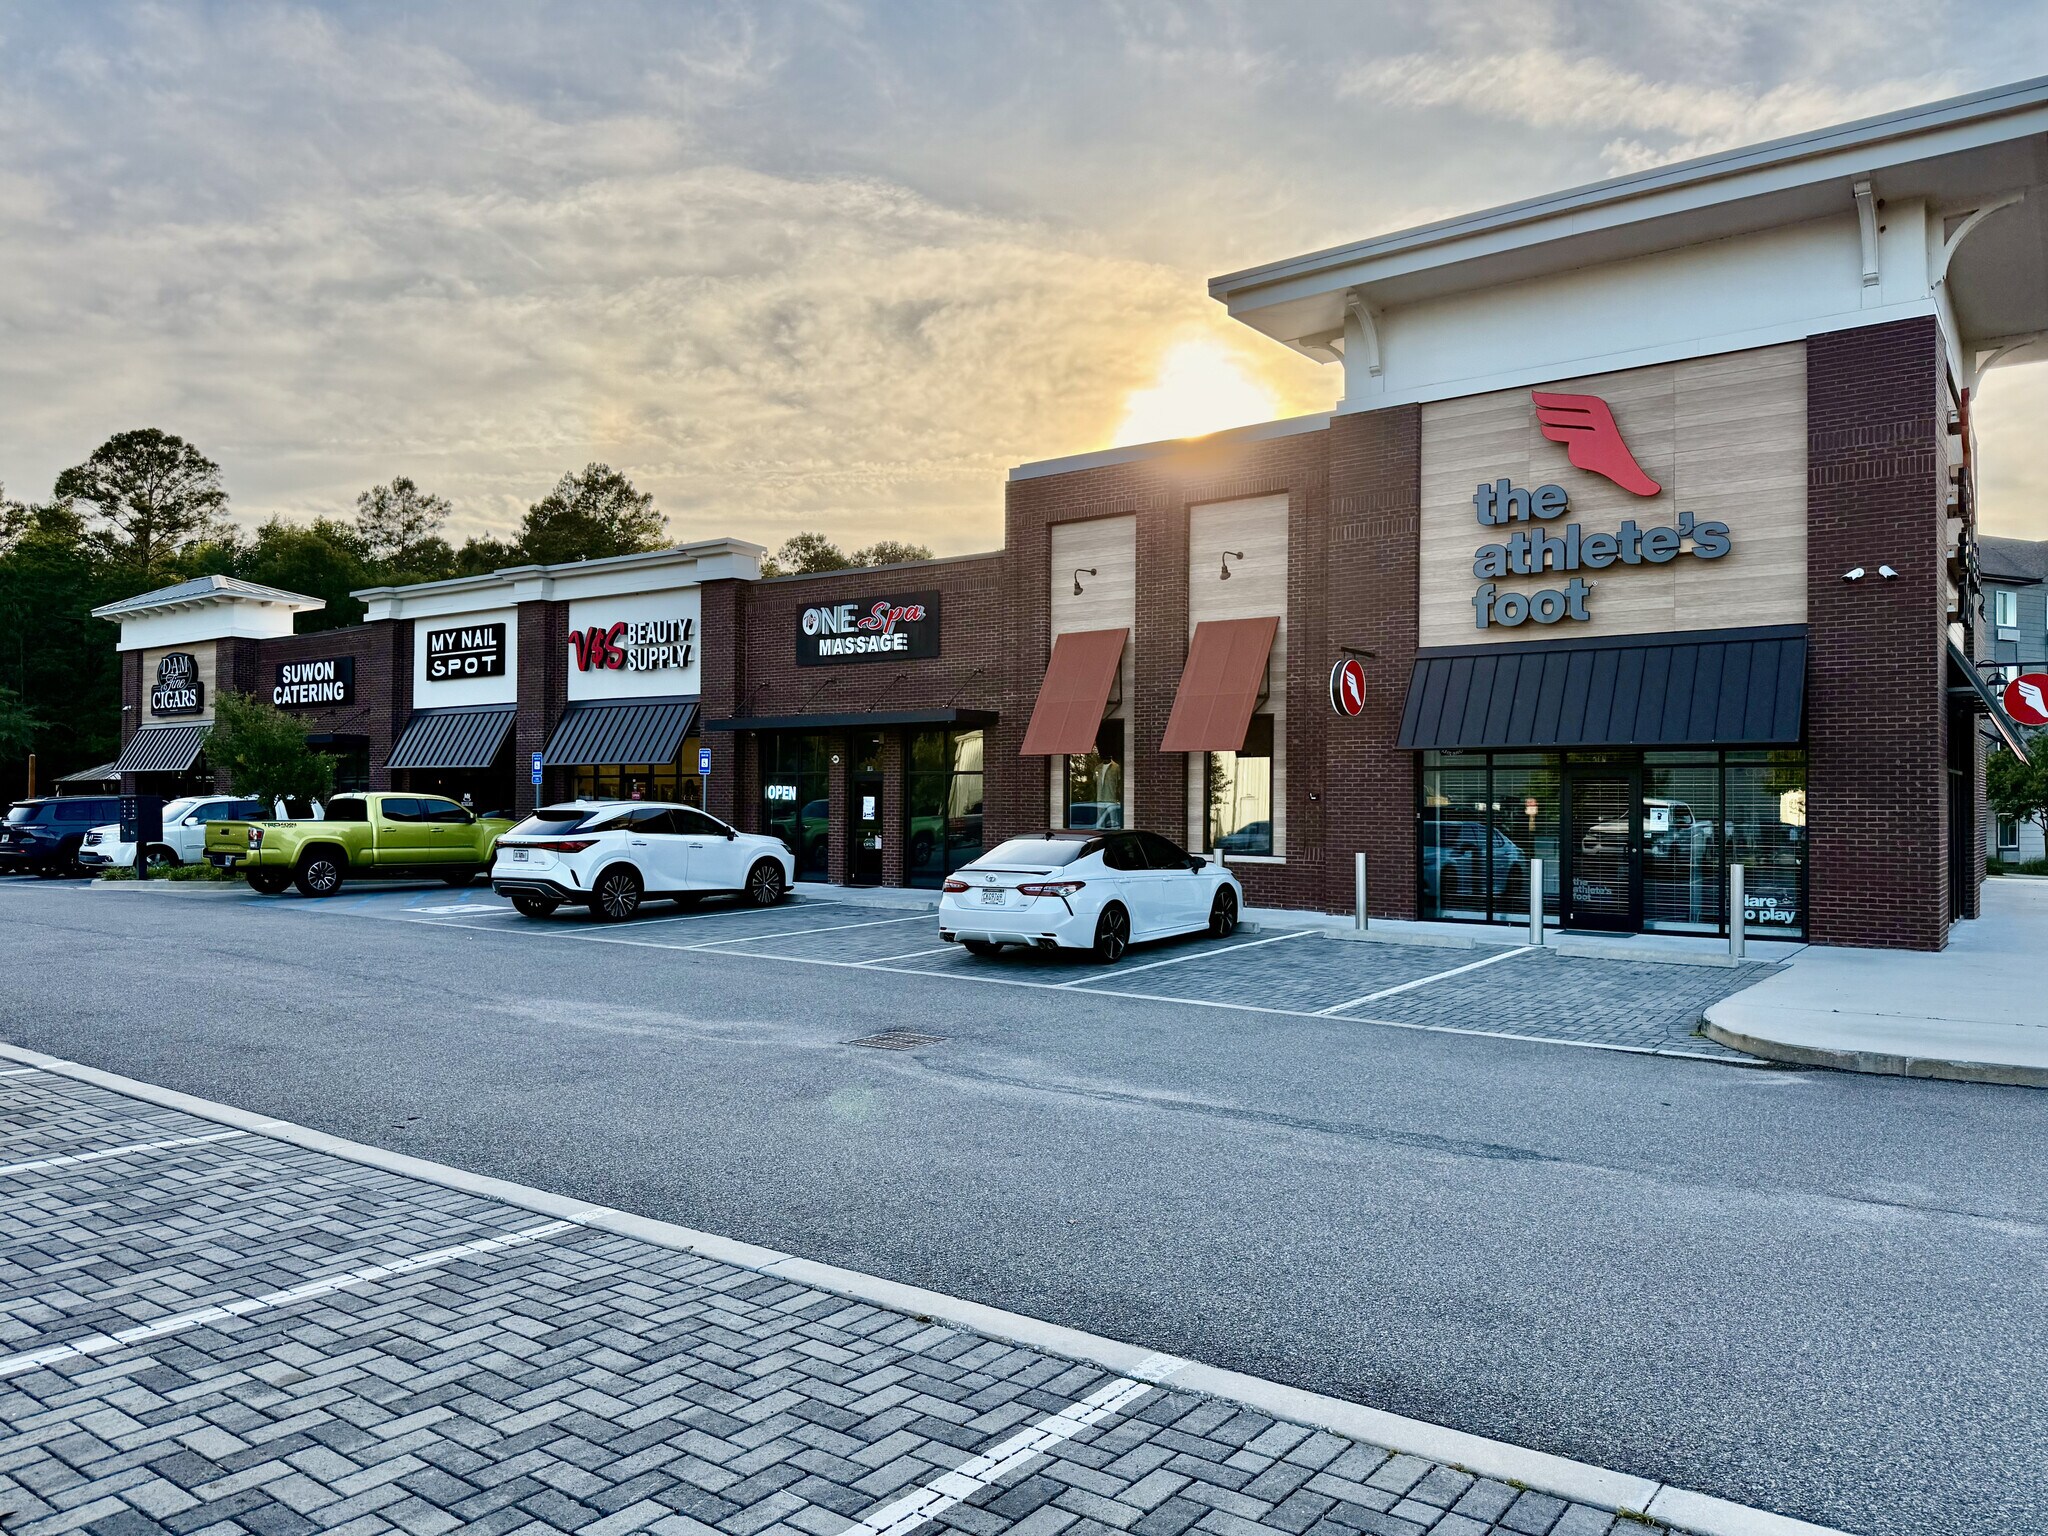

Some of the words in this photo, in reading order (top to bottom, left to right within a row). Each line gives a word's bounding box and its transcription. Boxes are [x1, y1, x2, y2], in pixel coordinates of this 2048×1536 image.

[1473, 478, 1569, 526] the
[1473, 511, 1732, 579] athlete's
[1472, 577, 1591, 629] foot
[802, 604, 859, 635] ONE
[857, 601, 926, 634] Spa
[431, 632, 457, 651] MY
[461, 628, 497, 648] NAIL
[628, 618, 692, 645] BEAUTY
[819, 633, 908, 656] MASSAGE
[162, 656, 188, 675] DAM
[431, 655, 497, 677] SPOT
[628, 645, 692, 671] SUPPLY
[161, 673, 186, 692] Fine
[282, 661, 335, 684] SUWON
[152, 689, 197, 709] CIGARS
[273, 681, 344, 705] CATERING
[767, 784, 797, 801] OPEN
[1759, 908, 1796, 924] play
